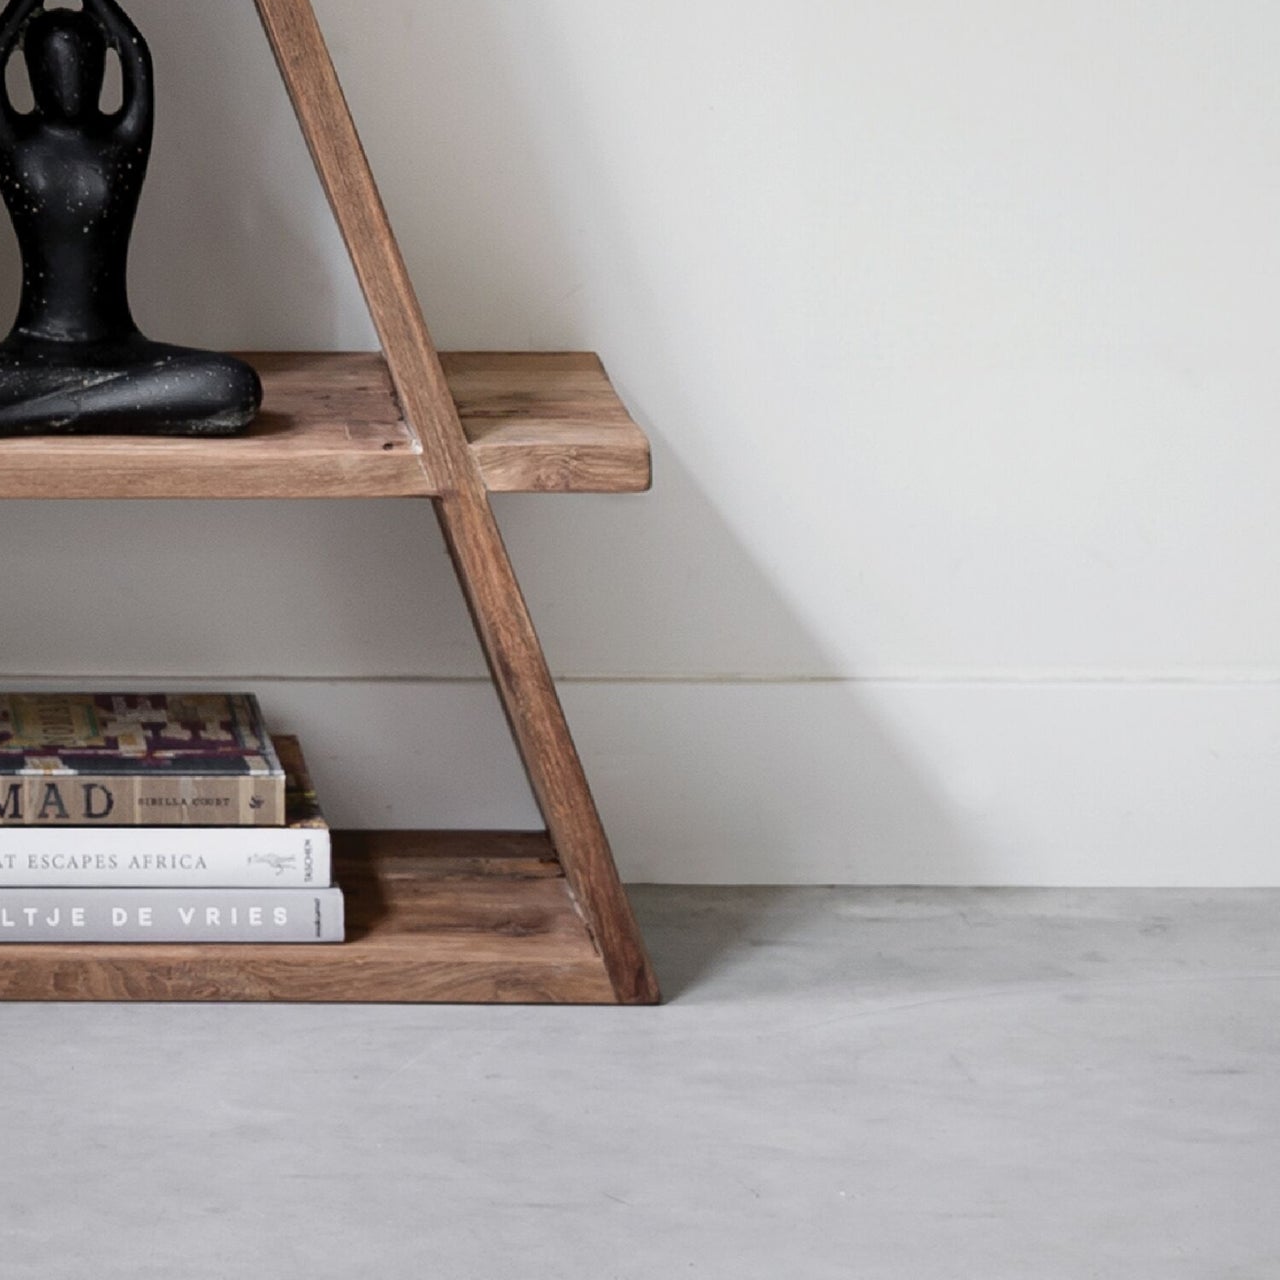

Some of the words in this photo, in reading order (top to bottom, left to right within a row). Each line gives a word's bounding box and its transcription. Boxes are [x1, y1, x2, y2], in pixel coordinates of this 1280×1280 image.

[27, 853, 118, 870] ESCAPES
[128, 853, 208, 870] AFRICA
[112, 907, 153, 927] DE
[178, 906, 289, 927] VRIES
